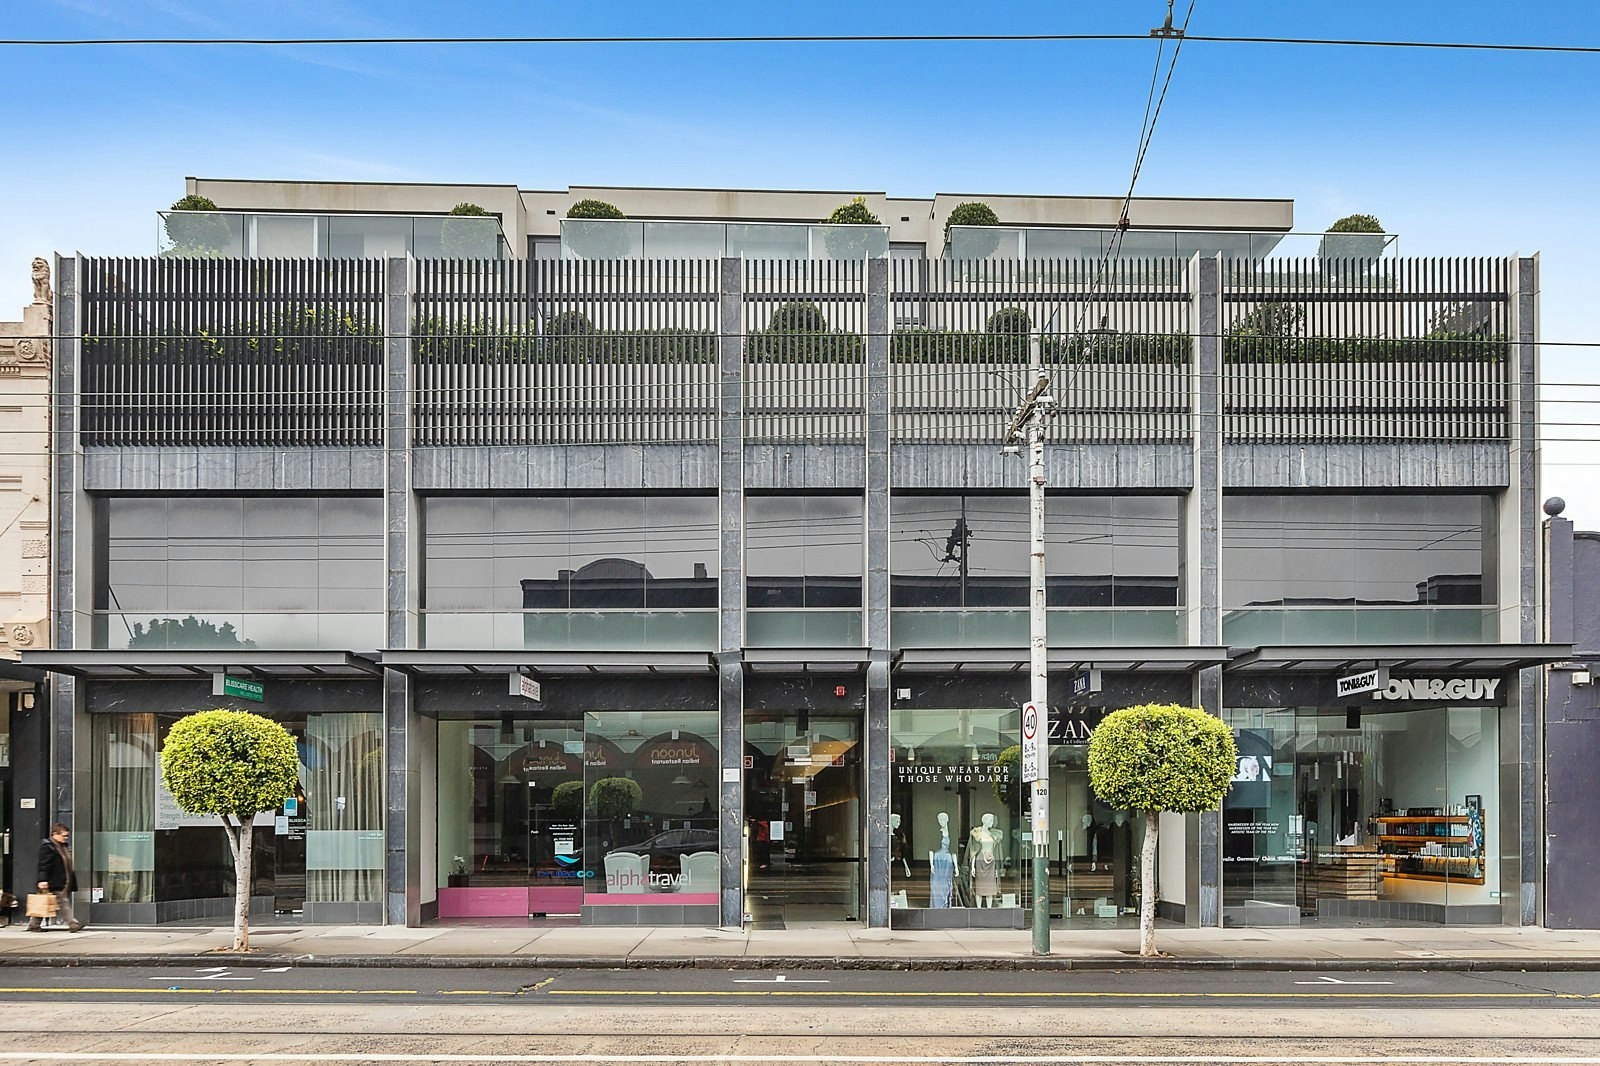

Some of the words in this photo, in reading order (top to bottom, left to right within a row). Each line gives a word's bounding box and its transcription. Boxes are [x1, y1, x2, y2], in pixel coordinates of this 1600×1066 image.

[247, 684, 263, 694] HEALTH
[1339, 674, 1377, 692] TONI&GUY
[1025, 714, 1035, 731] 40
[899, 766, 942, 775] UNIQUE
[949, 766, 980, 774] WEAR
[987, 766, 1009, 774] FOR
[899, 775, 938, 783] THOSE
[945, 775, 972, 783] WHO
[979, 775, 1009, 783] DARE
[607, 869, 692, 890] alphatravel
